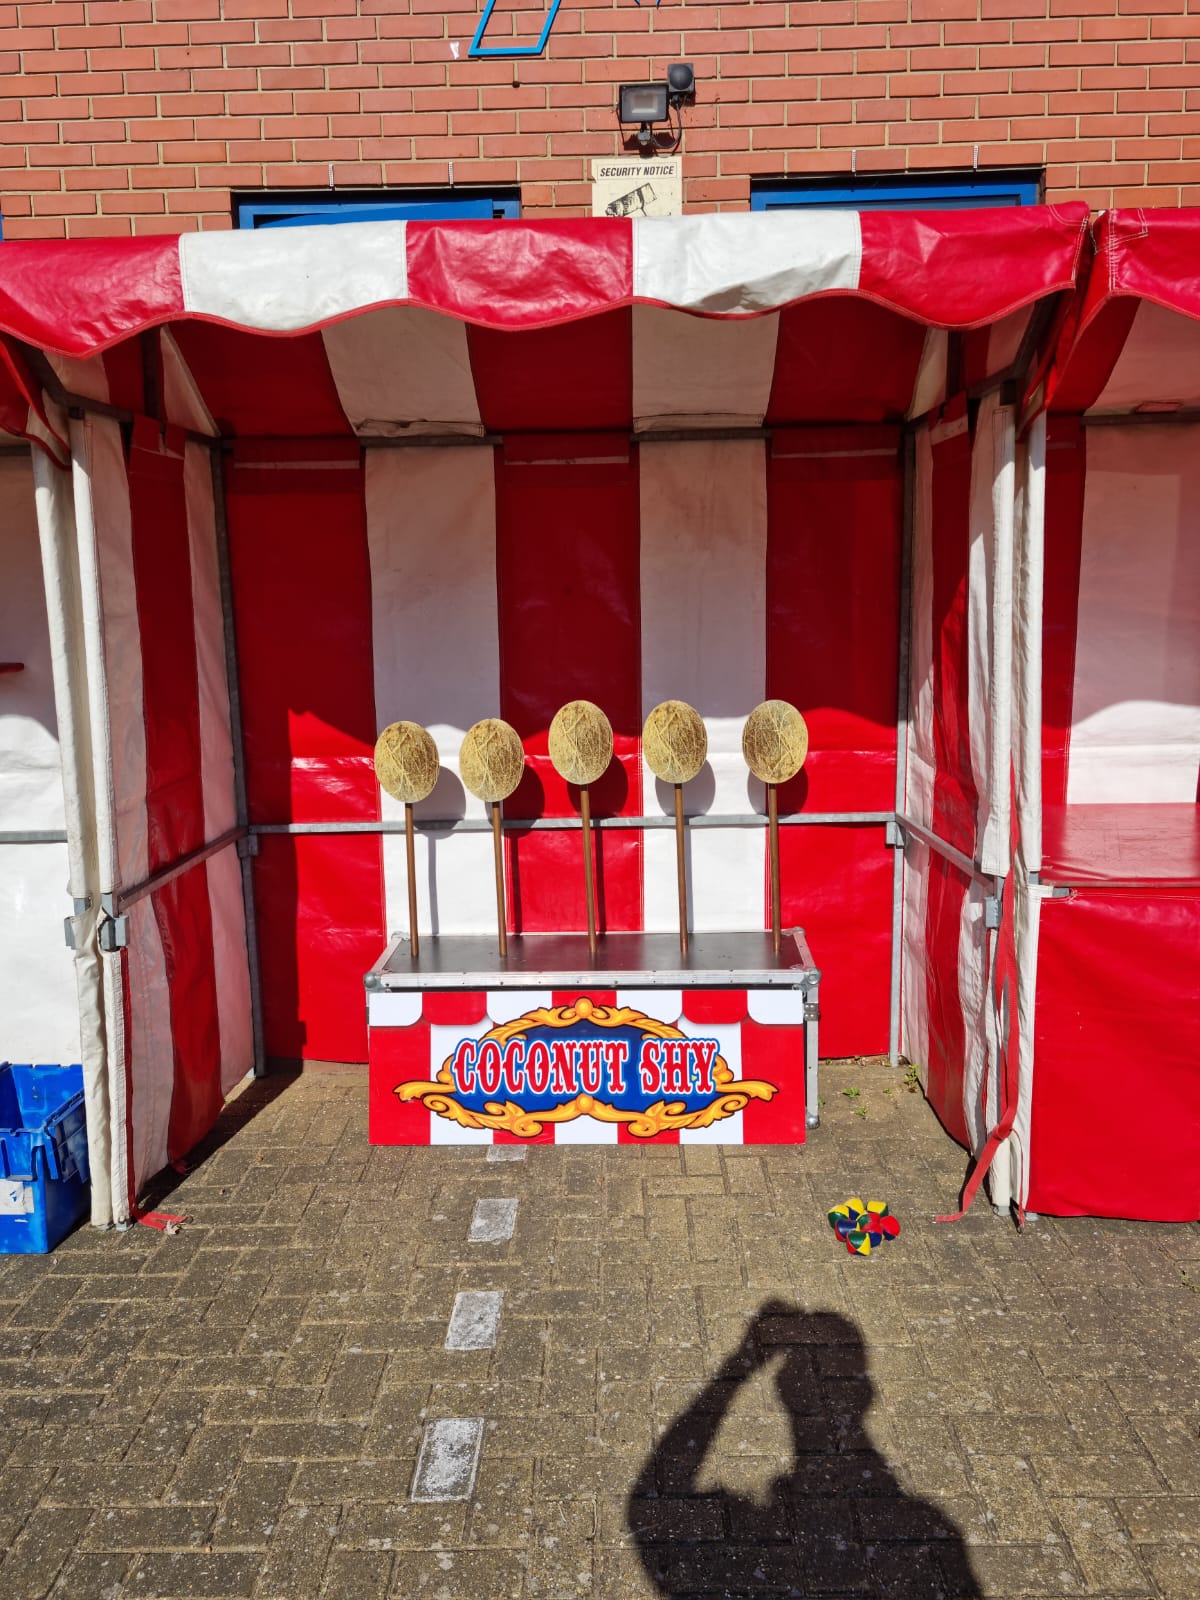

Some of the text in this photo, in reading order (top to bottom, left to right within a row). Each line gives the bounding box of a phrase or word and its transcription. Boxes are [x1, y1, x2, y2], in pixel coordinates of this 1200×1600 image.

[600, 165, 674, 177] SECURITY NOTICE
[453, 1039, 717, 1094] COCONUT SHY
